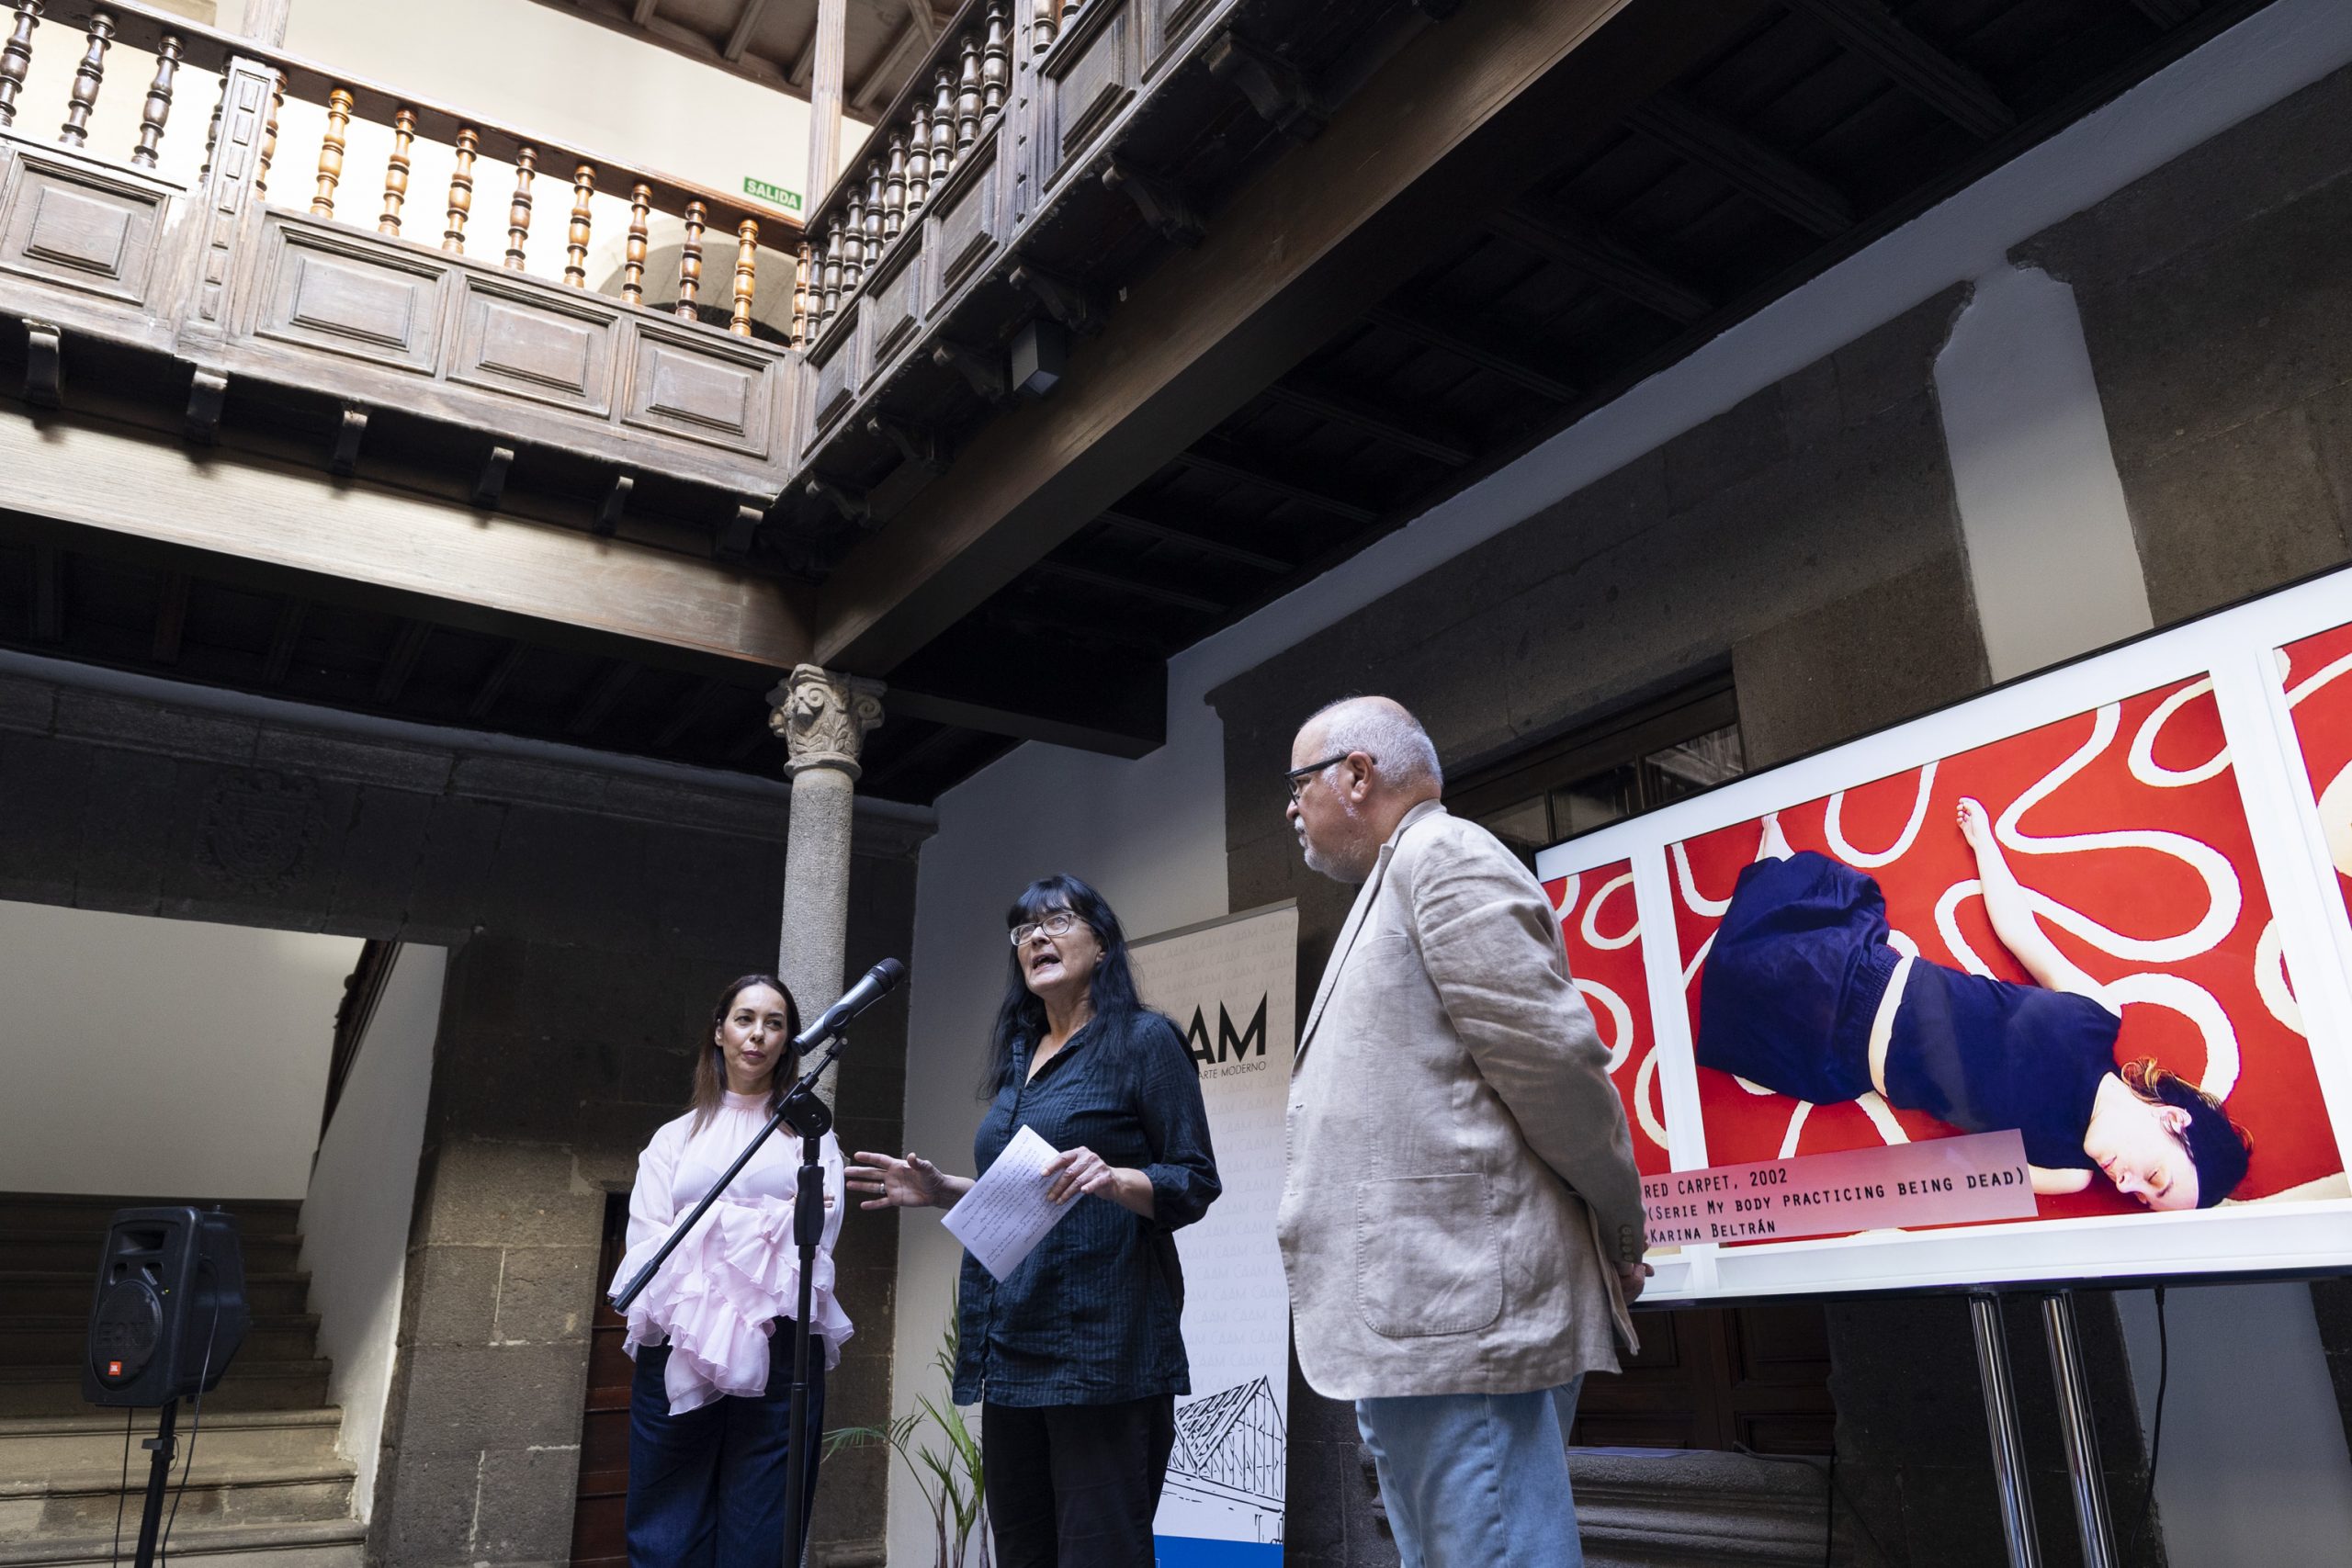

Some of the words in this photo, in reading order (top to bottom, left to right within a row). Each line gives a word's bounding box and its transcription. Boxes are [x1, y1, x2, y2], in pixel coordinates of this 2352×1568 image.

[746, 180, 798, 208] SALIDA
[1188, 990, 1268, 1065] AM
[1198, 1068, 1218, 1080] ARTE
[1221, 1060, 1266, 1077] MODERNO
[1644, 1182, 1668, 1199] RED
[1678, 1175, 1738, 1195] CARPET,
[1750, 1168, 1787, 1187] 2002
[1736, 1197, 1771, 1212] BODY
[1783, 1185, 1885, 1207] PRACTICING
[1897, 1178, 1953, 1195] BEING
[1966, 1167, 2024, 1189] DEAD)
[1649, 1227, 1702, 1243] KARINA
